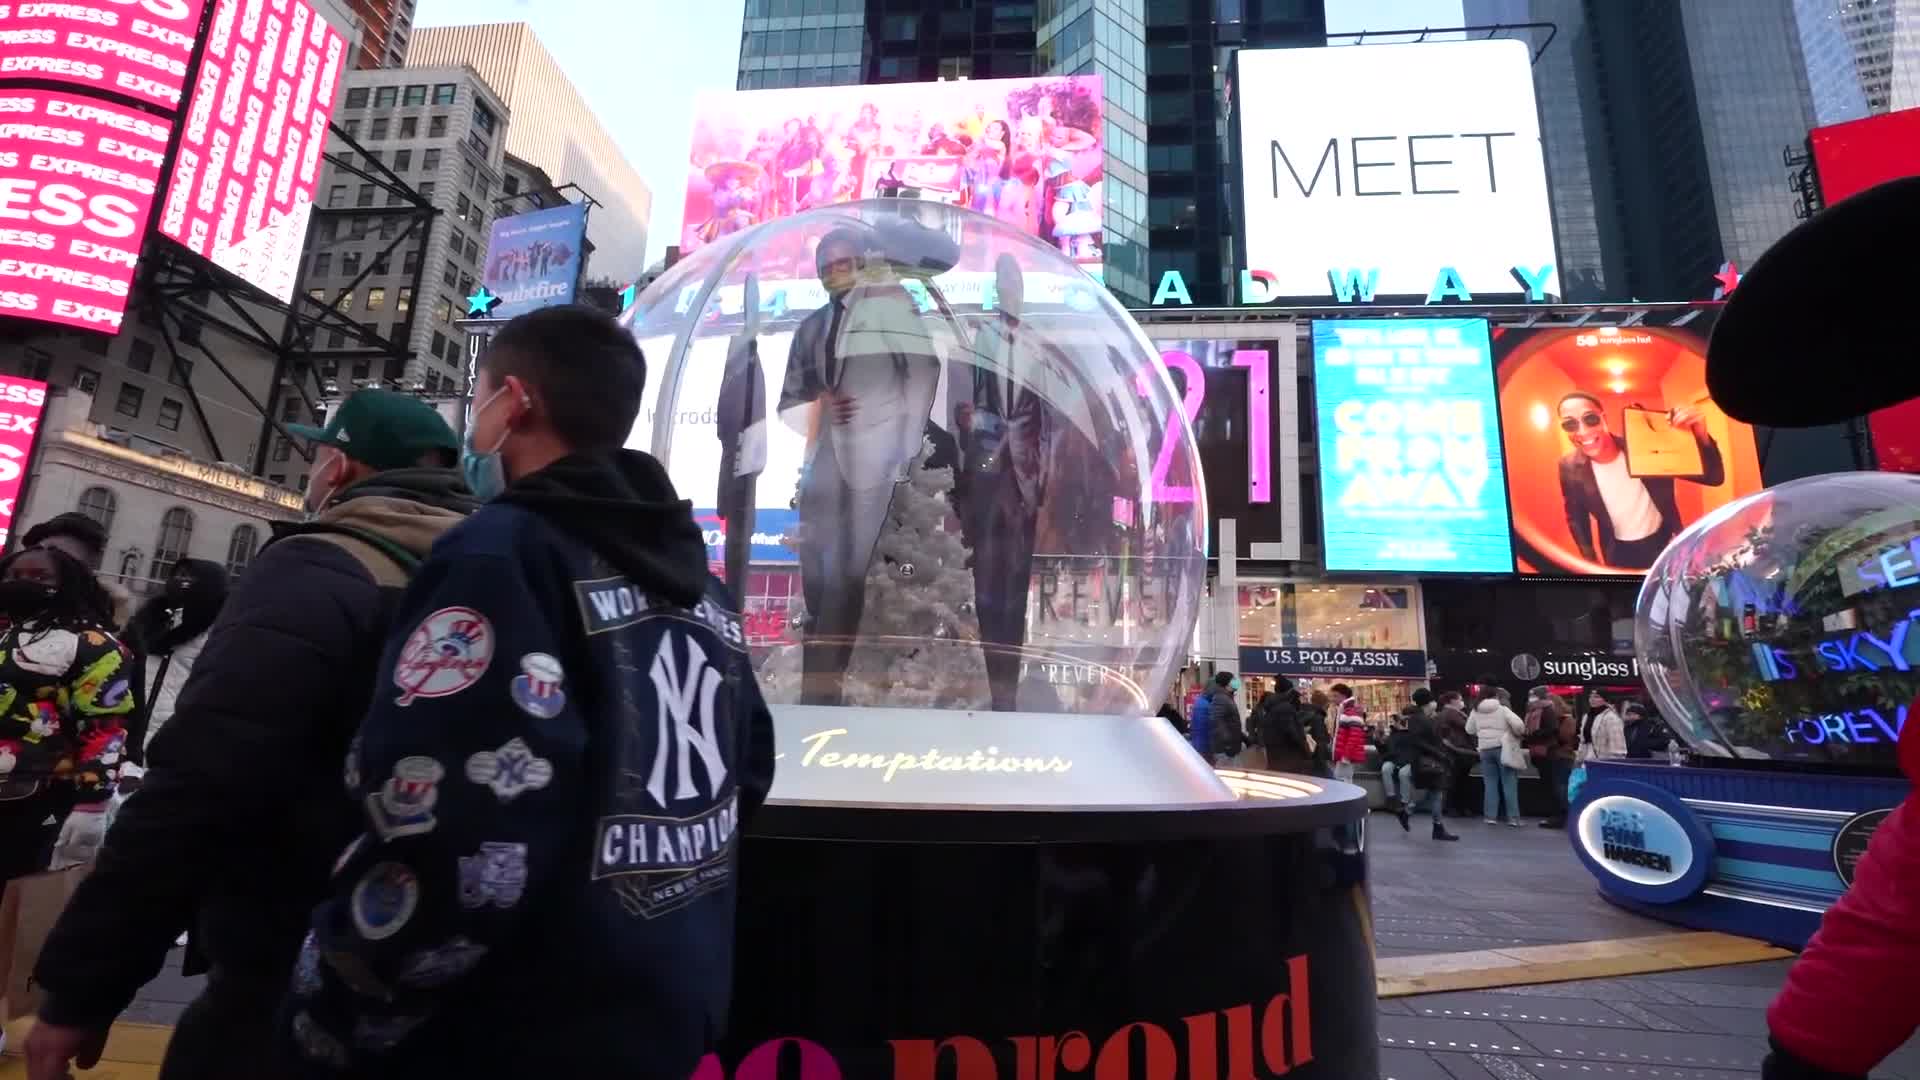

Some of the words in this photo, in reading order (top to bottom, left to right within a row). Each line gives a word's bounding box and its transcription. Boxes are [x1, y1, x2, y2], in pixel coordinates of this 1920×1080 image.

[18, 3, 119, 27] EXPRESS
[1, 56, 104, 80] EXPRESS
[66, 31, 187, 77] EXPRESS
[46, 100, 170, 142] EXPRESS
[30, 154, 156, 195] EXPRESS
[1270, 132, 1516, 198] MEET
[0, 259, 129, 296] EXPRESS
[1136, 349, 1272, 503] 21
[1265, 650, 1295, 665] U.S.
[1299, 651, 1347, 665] POLO
[1350, 652, 1403, 667] ASSN.
[1543, 657, 1630, 681] sunglass
[801, 727, 1073, 784] Temptations
